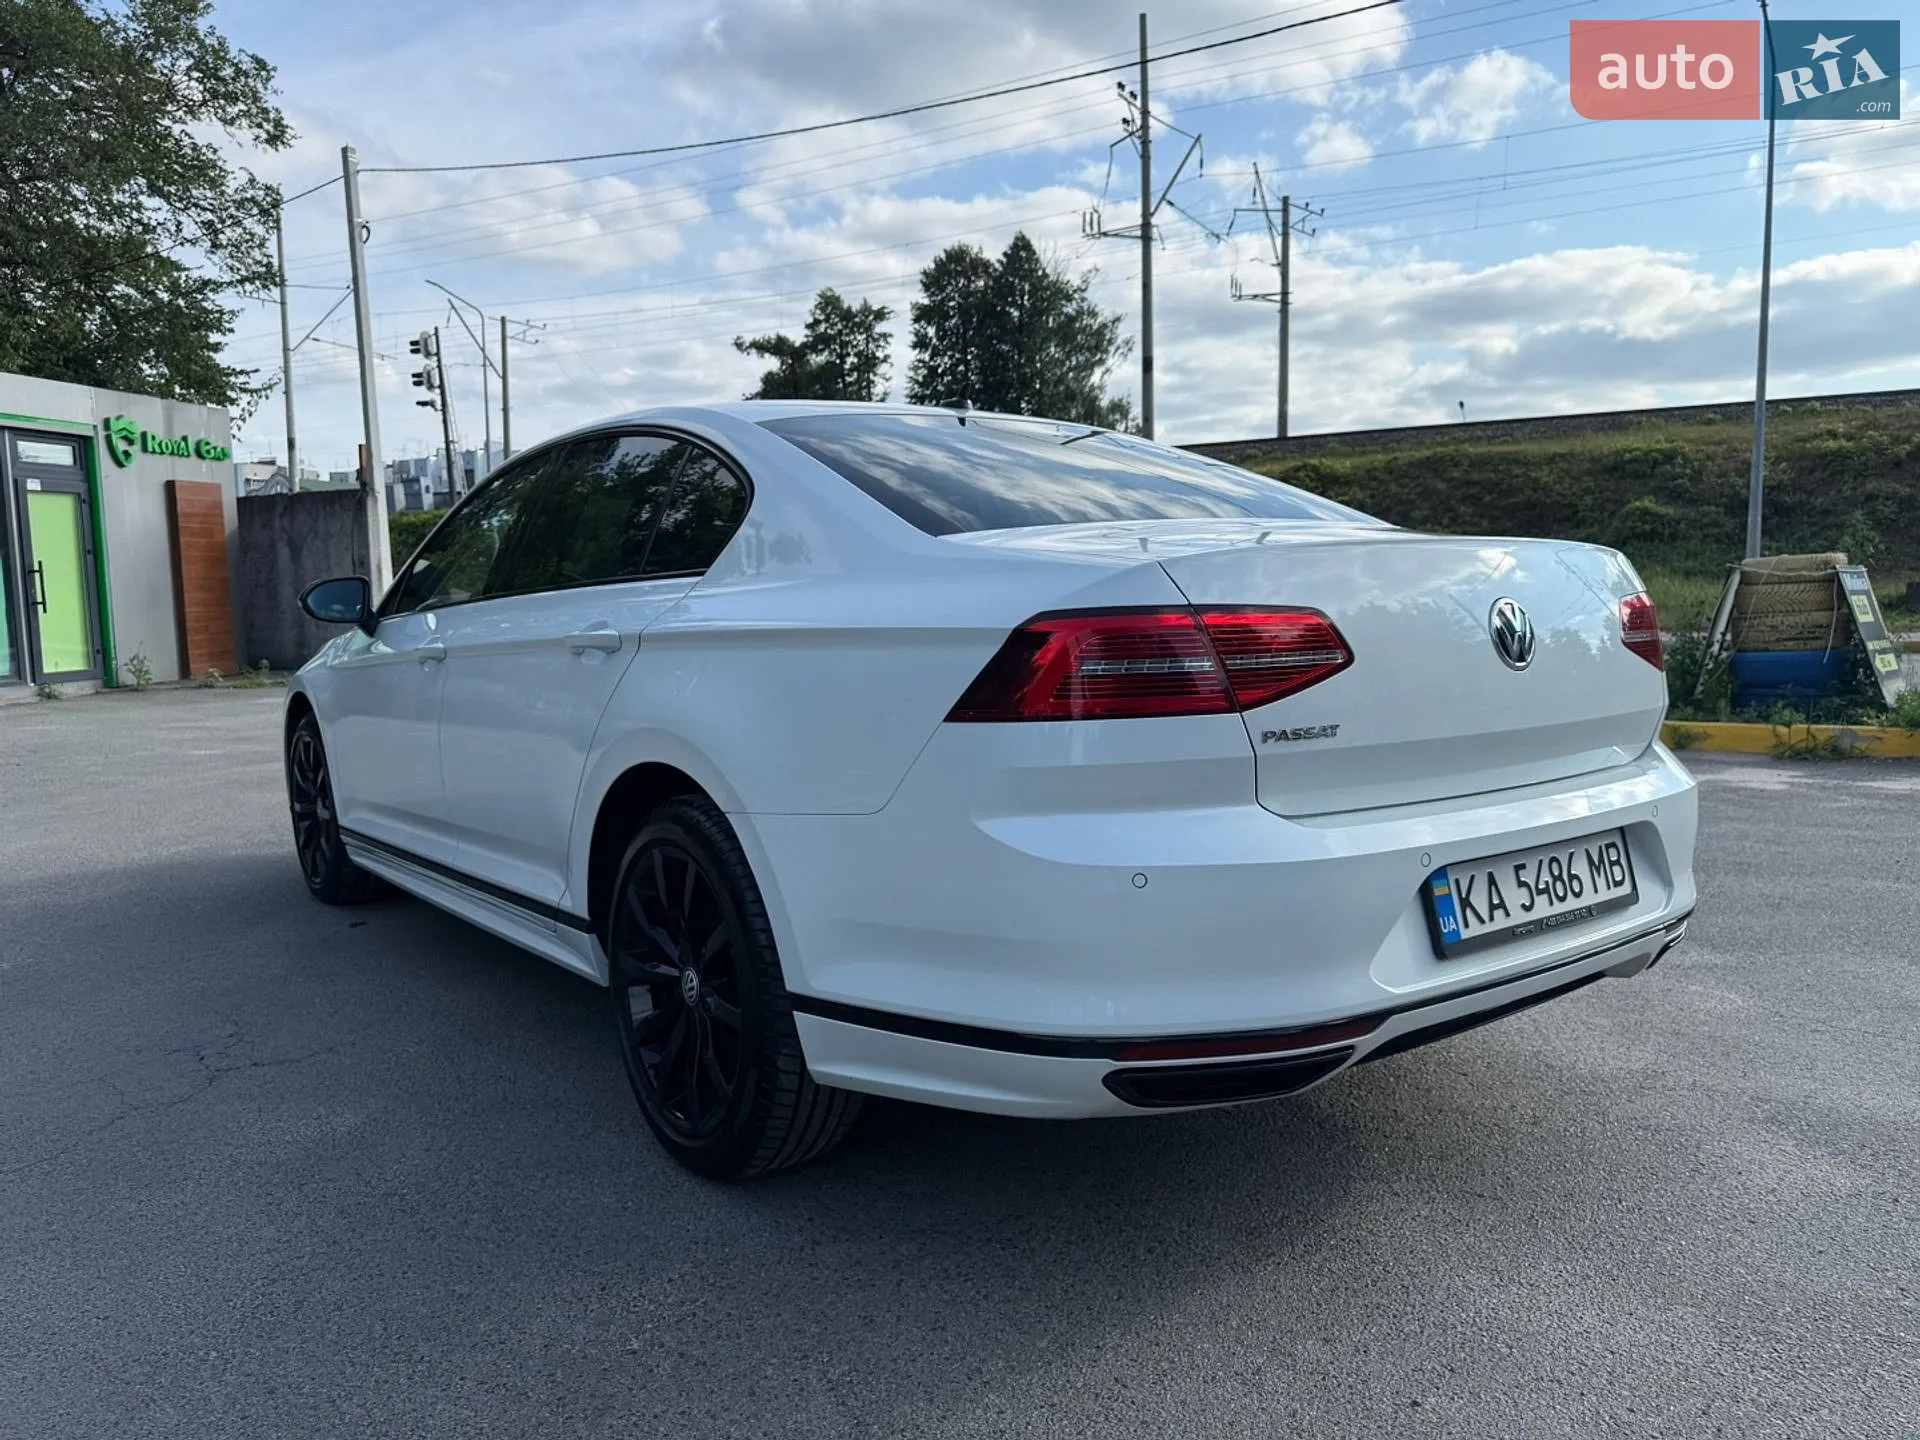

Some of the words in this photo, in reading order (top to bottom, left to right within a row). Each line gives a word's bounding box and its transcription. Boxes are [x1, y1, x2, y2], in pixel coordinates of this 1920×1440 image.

[1261, 723, 1340, 744] PASSAT
[1454, 870, 1511, 929] KA
[1513, 850, 1584, 912] 5486
[1584, 841, 1626, 894] MB
[1439, 916, 1458, 933] UA
